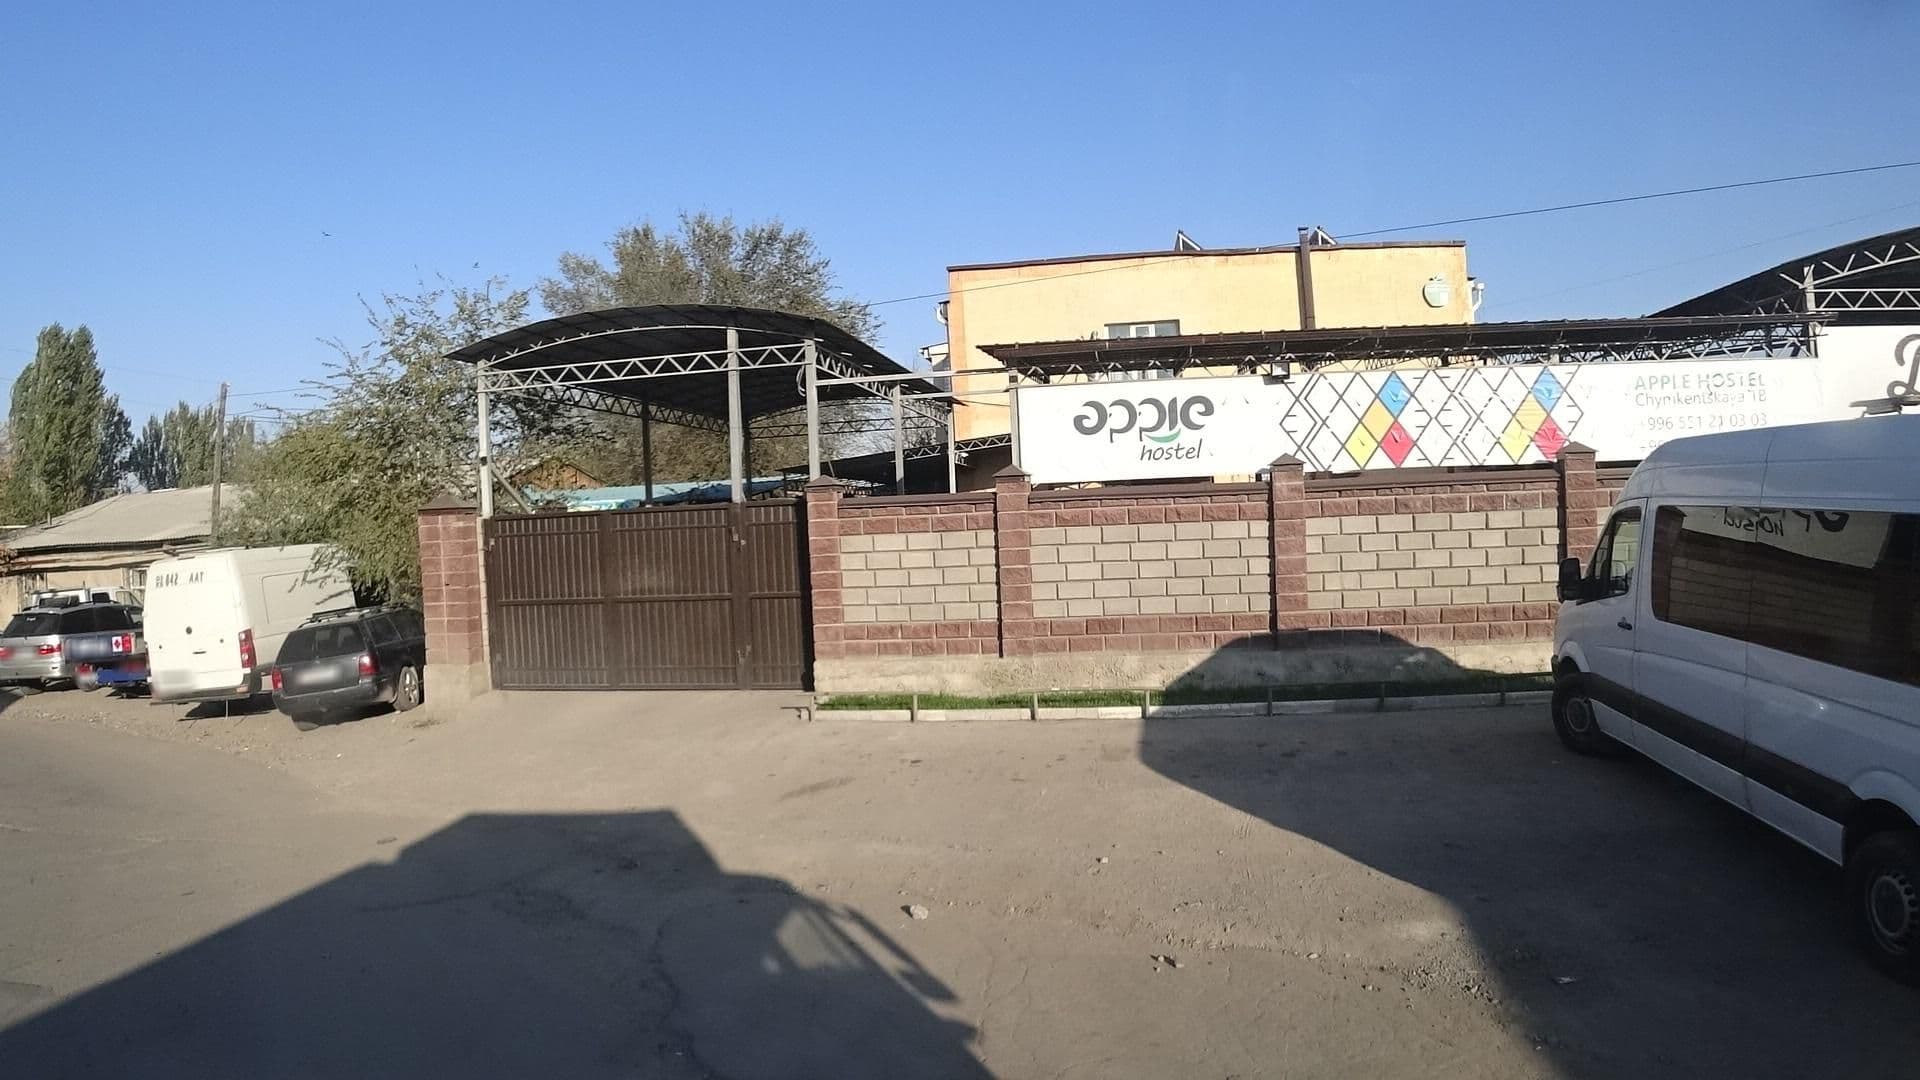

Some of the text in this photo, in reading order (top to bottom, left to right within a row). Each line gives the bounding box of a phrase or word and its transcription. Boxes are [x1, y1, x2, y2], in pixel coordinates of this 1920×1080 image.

[1635, 372, 1765, 391] APPLE HOSTEL
[1140, 438, 1203, 461] hostel
